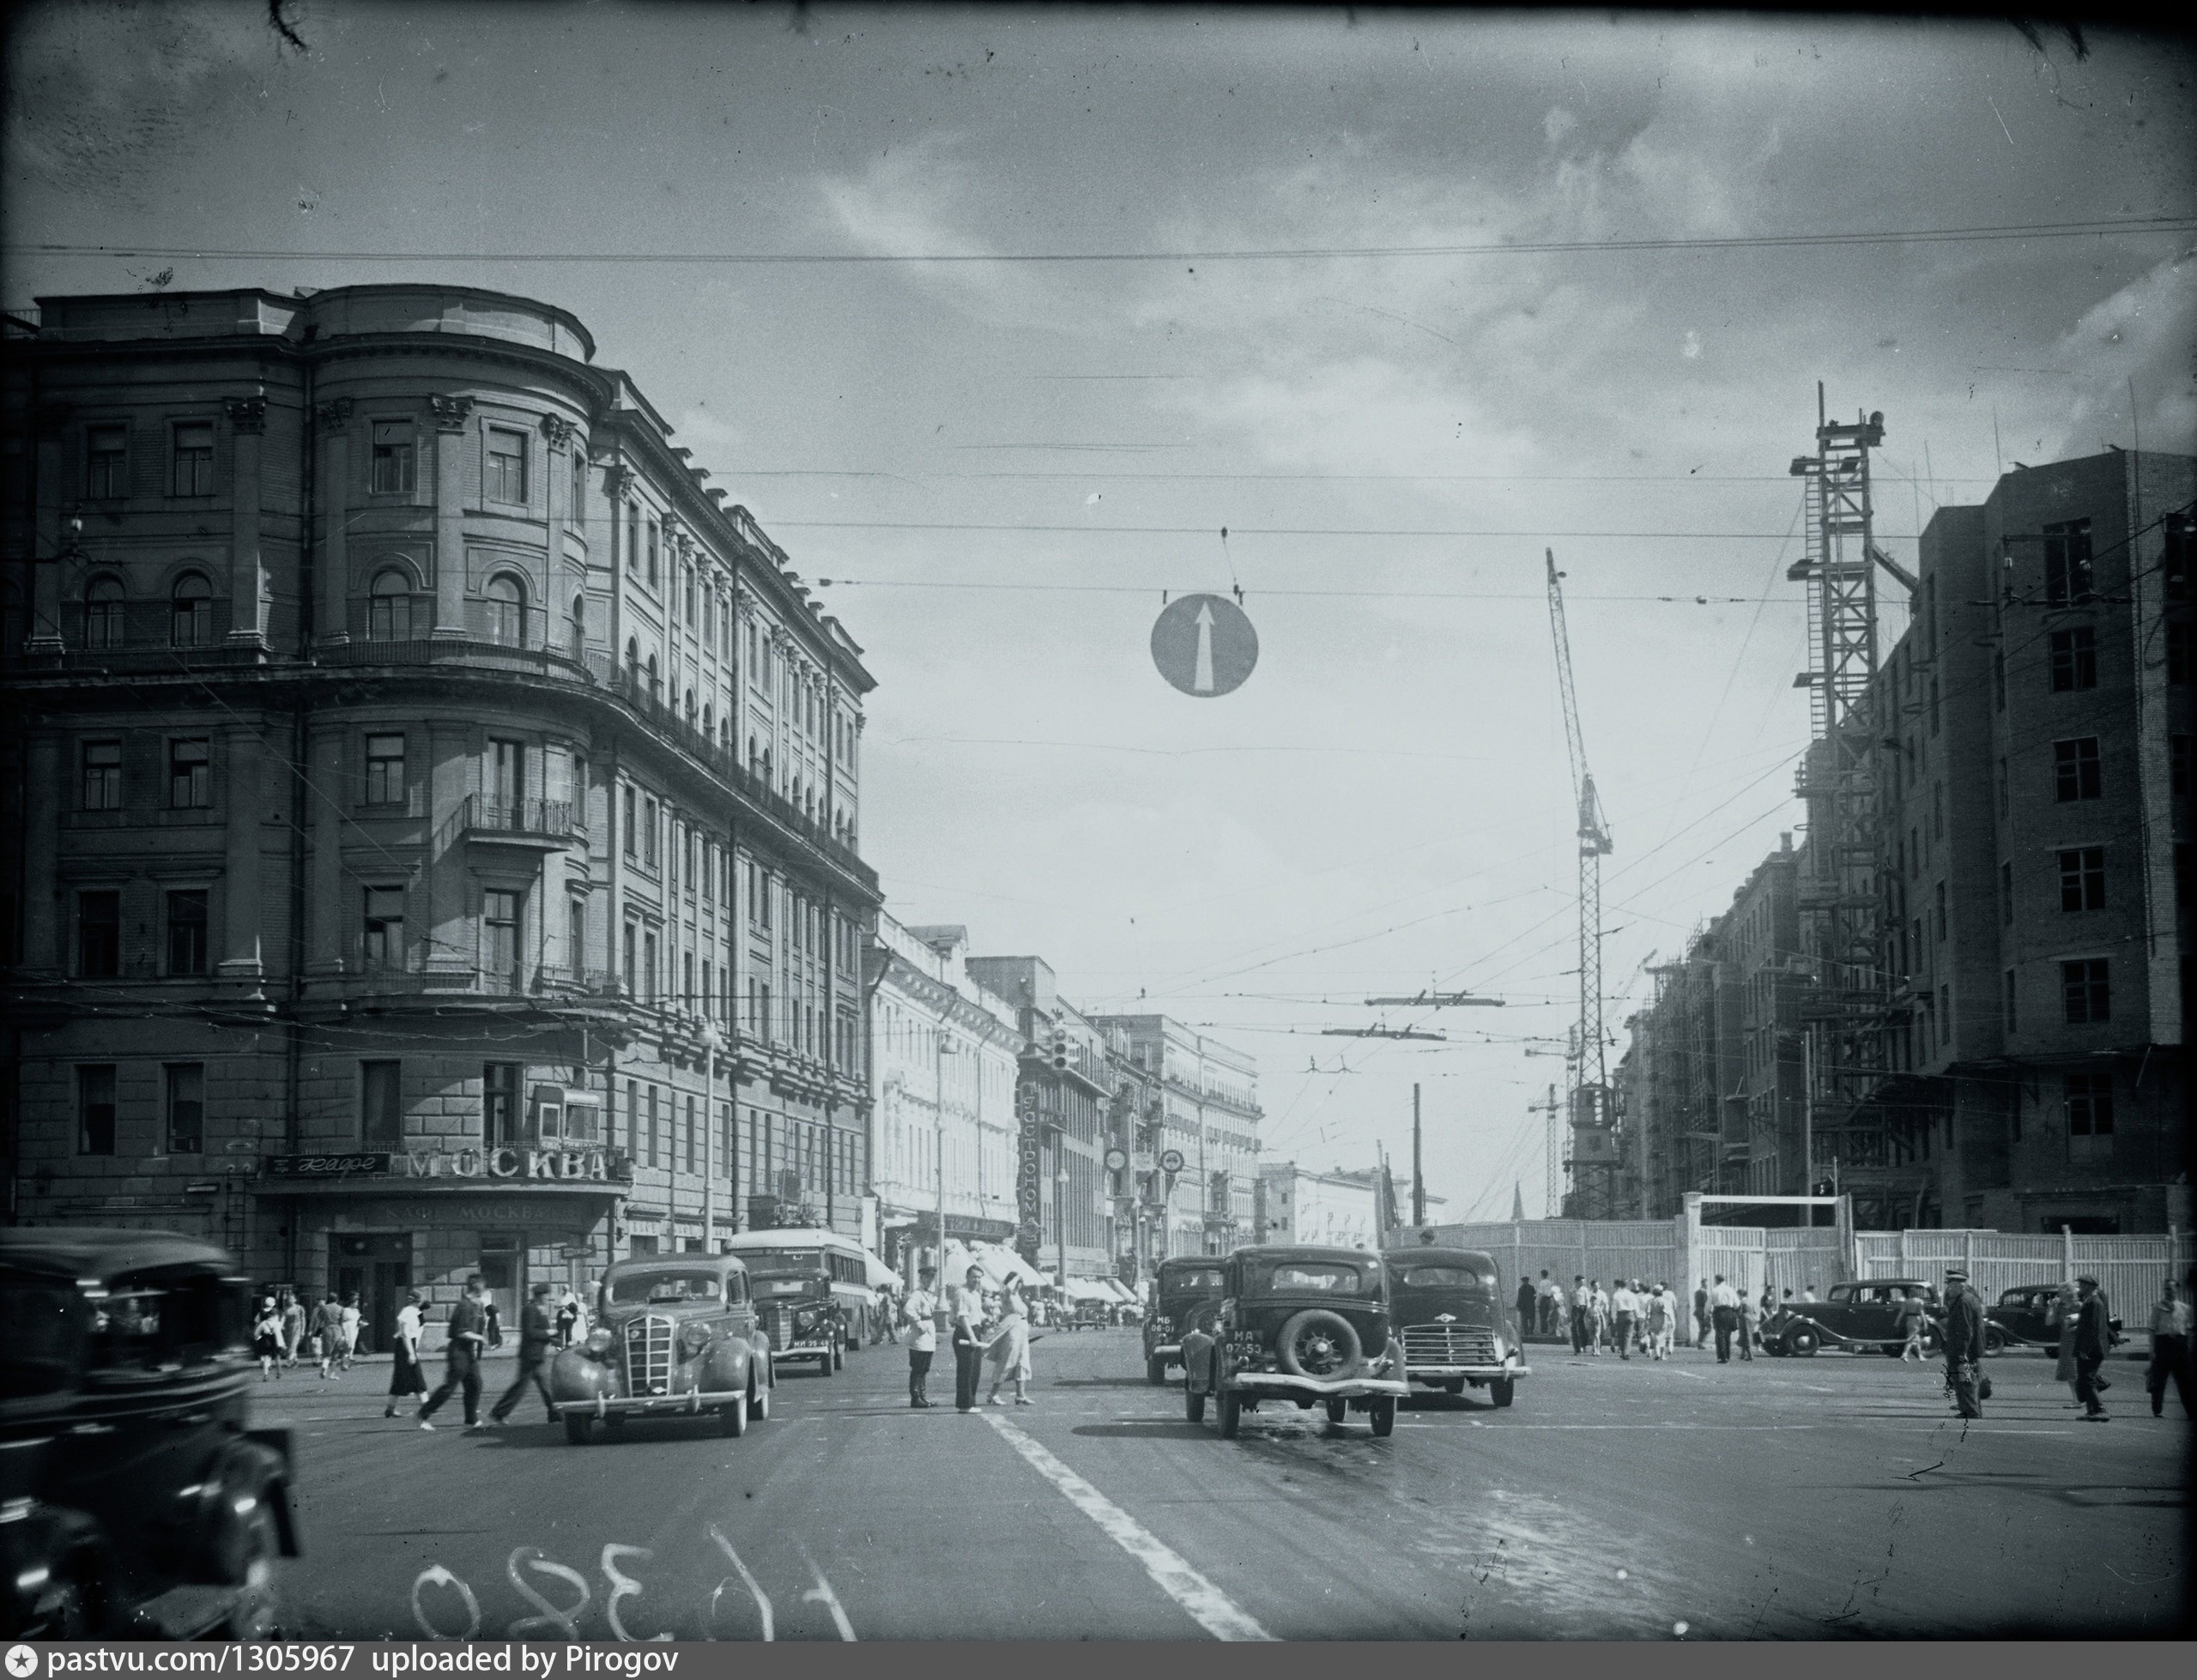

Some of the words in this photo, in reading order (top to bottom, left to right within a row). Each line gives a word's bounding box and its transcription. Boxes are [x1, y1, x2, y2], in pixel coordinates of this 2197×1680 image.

[407, 1147, 608, 1181] МОСКВА
[1157, 1316, 1171, 1325] МБ
[1234, 1330, 1254, 1342] МА
[1226, 1343, 1262, 1354] 07-53
